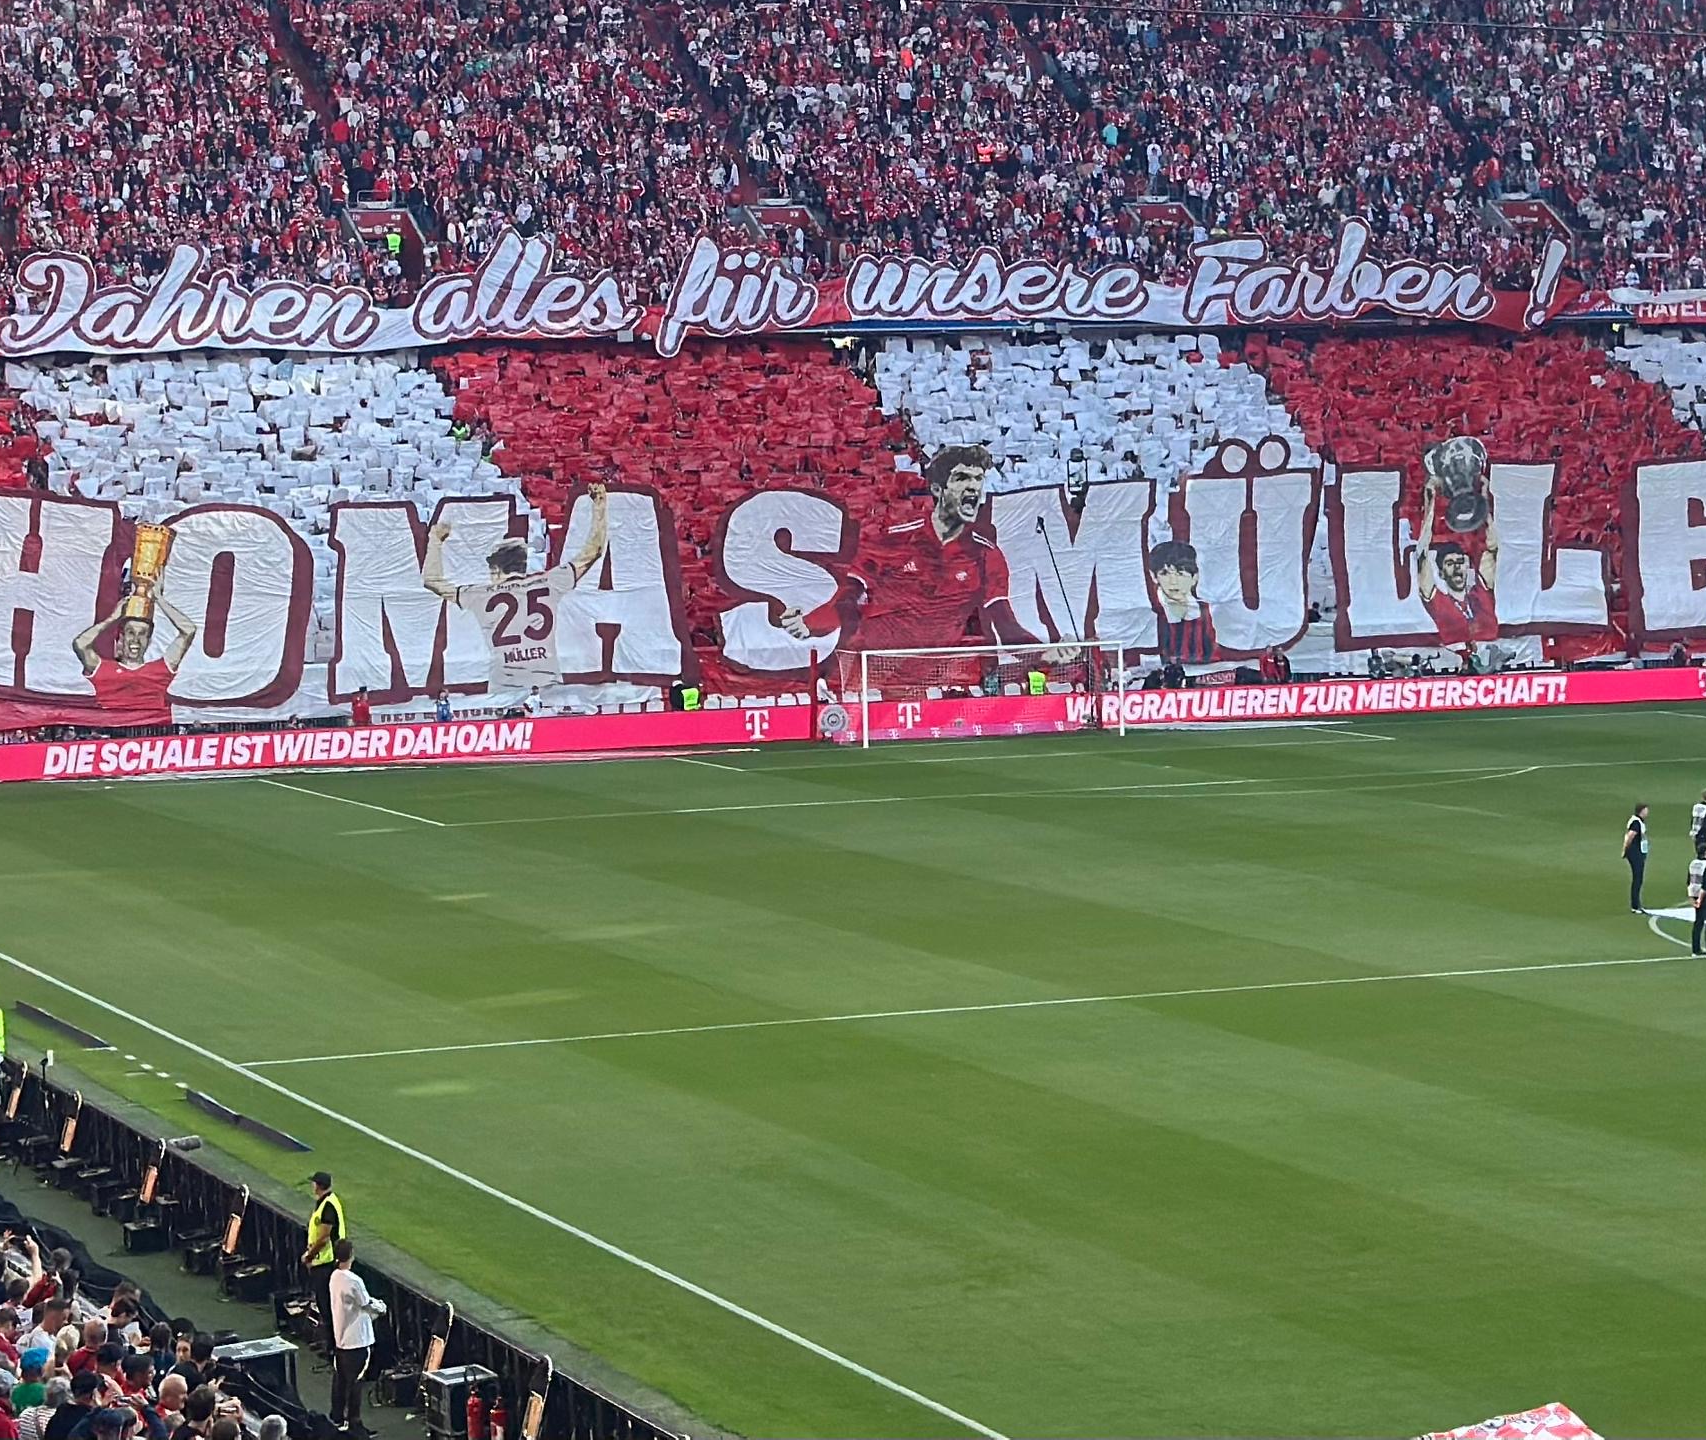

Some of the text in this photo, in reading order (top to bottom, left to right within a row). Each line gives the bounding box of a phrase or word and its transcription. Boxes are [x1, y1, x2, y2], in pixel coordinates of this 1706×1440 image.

[413, 226, 645, 338] alles
[656, 235, 817, 357] für
[847, 246, 1149, 320] unsere
[1183, 216, 1495, 323] Farben
[485, 586, 554, 647] 25
[503, 646, 548, 664] MÜLLER
[1125, 685, 1299, 722] GRATULIEREN
[1301, 682, 1352, 713] ZUR
[1355, 675, 1567, 711] MEISTERSCHAFT!
[43, 721, 533, 776] DIE SCHALE IST WIEDER DAHOAM!
